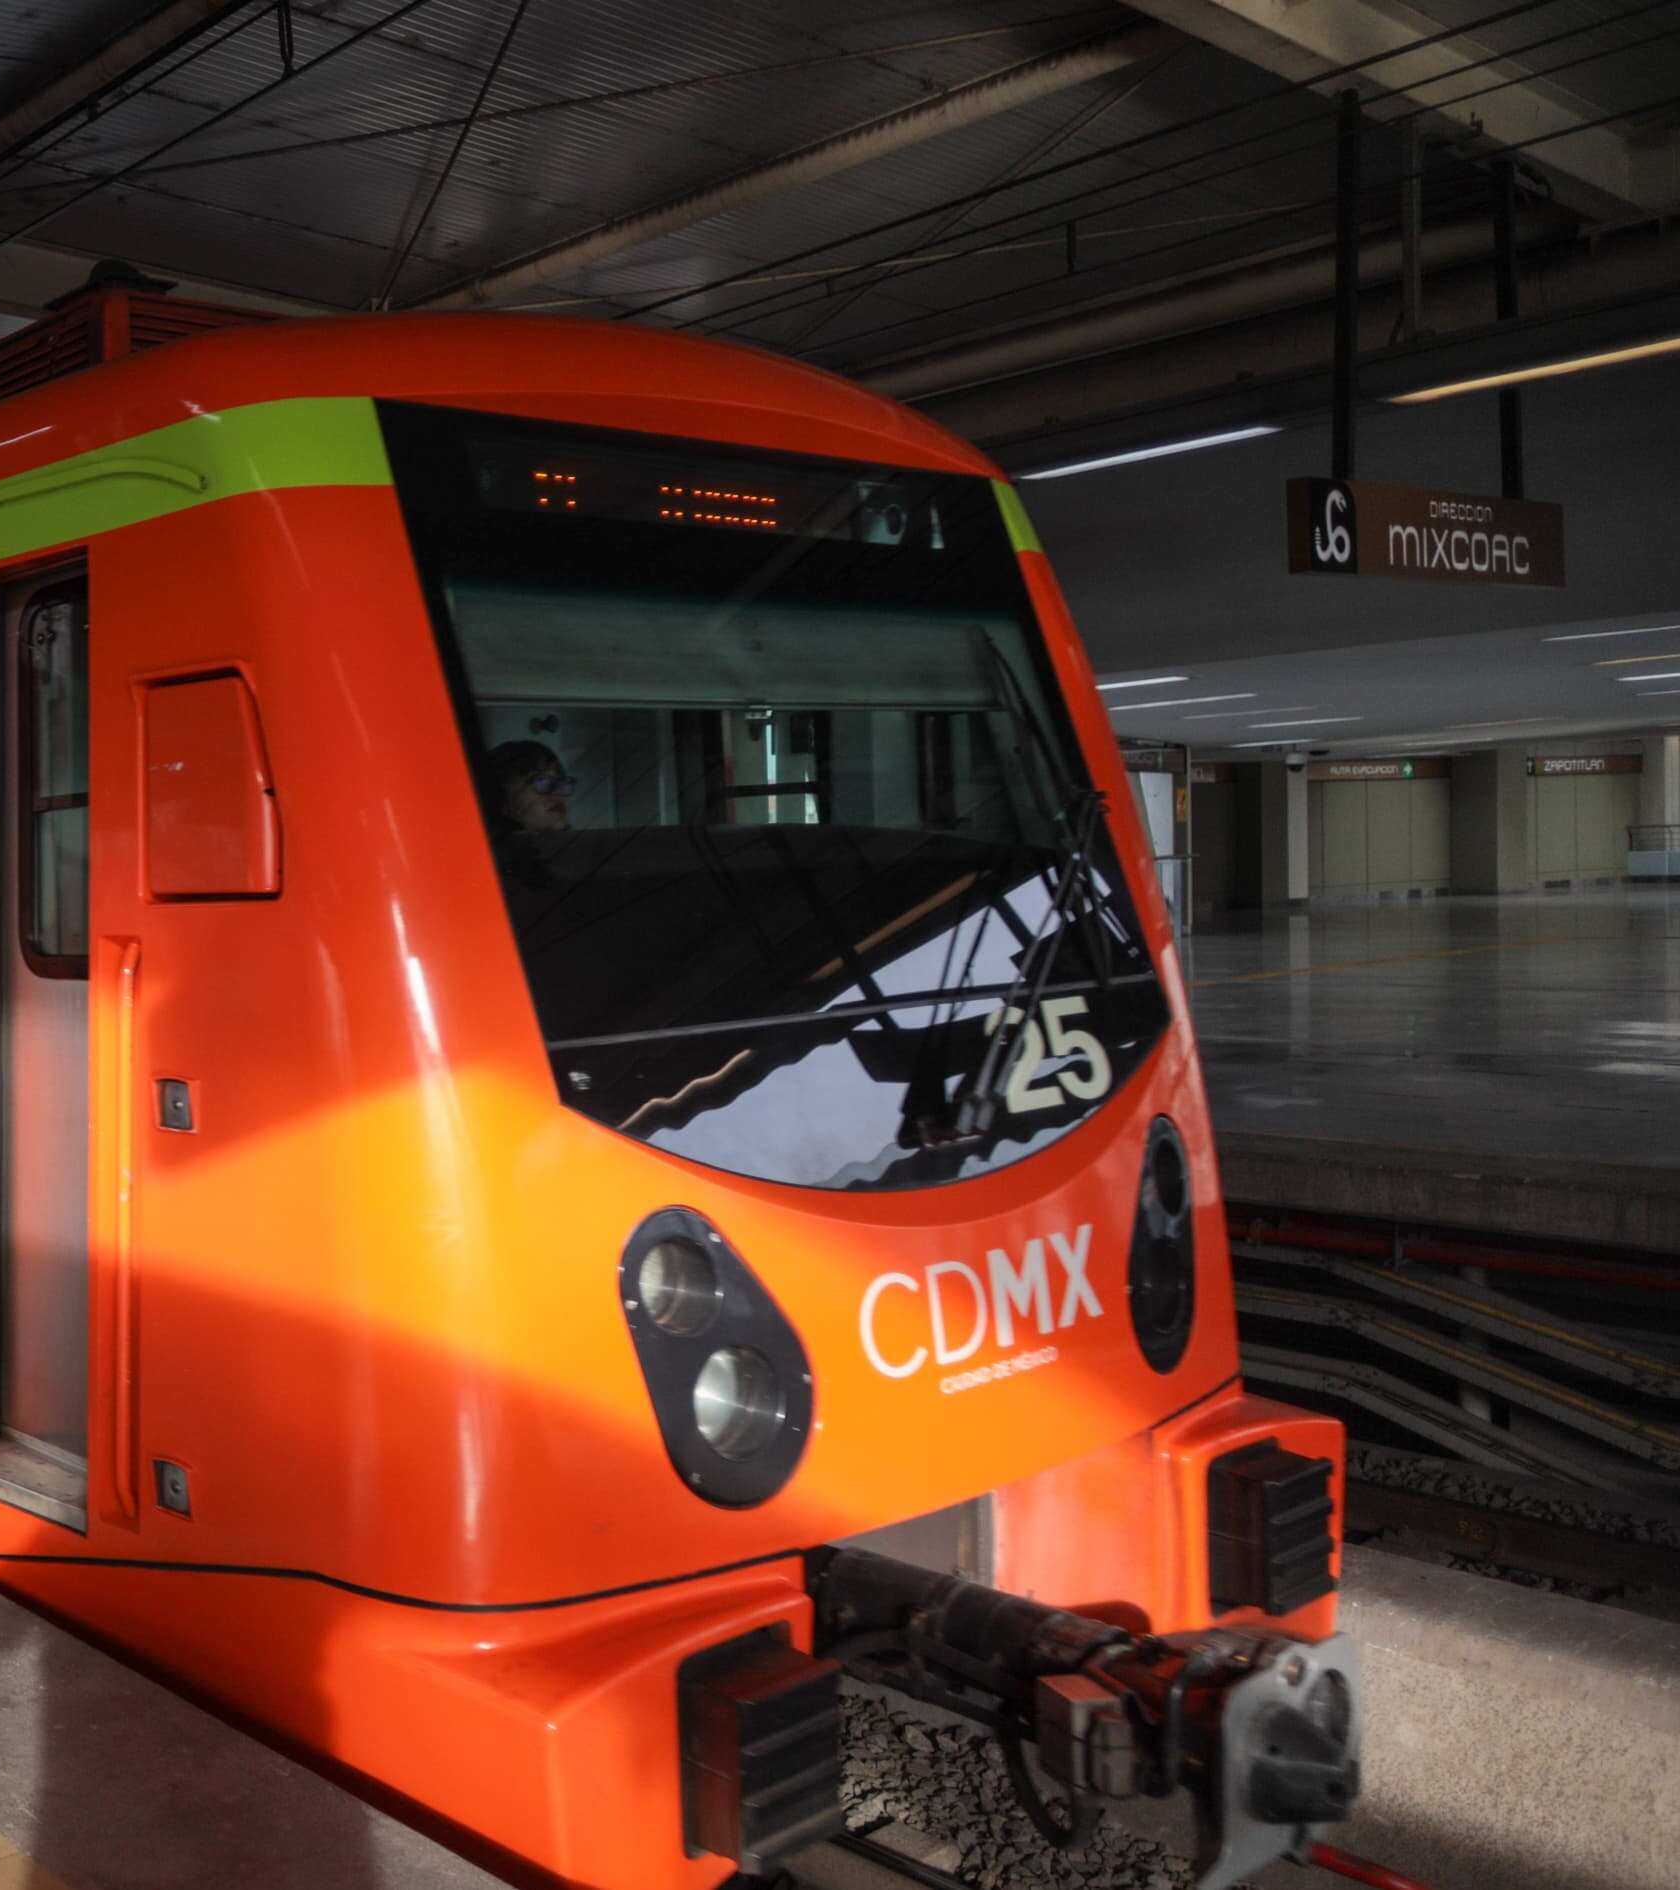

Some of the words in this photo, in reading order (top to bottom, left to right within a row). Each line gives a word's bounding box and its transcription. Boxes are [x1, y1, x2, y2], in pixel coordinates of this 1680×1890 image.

[1388, 523, 1530, 575] MIXCOAC
[984, 995, 1113, 1114] 25
[859, 1223, 1105, 1379] CDMX
